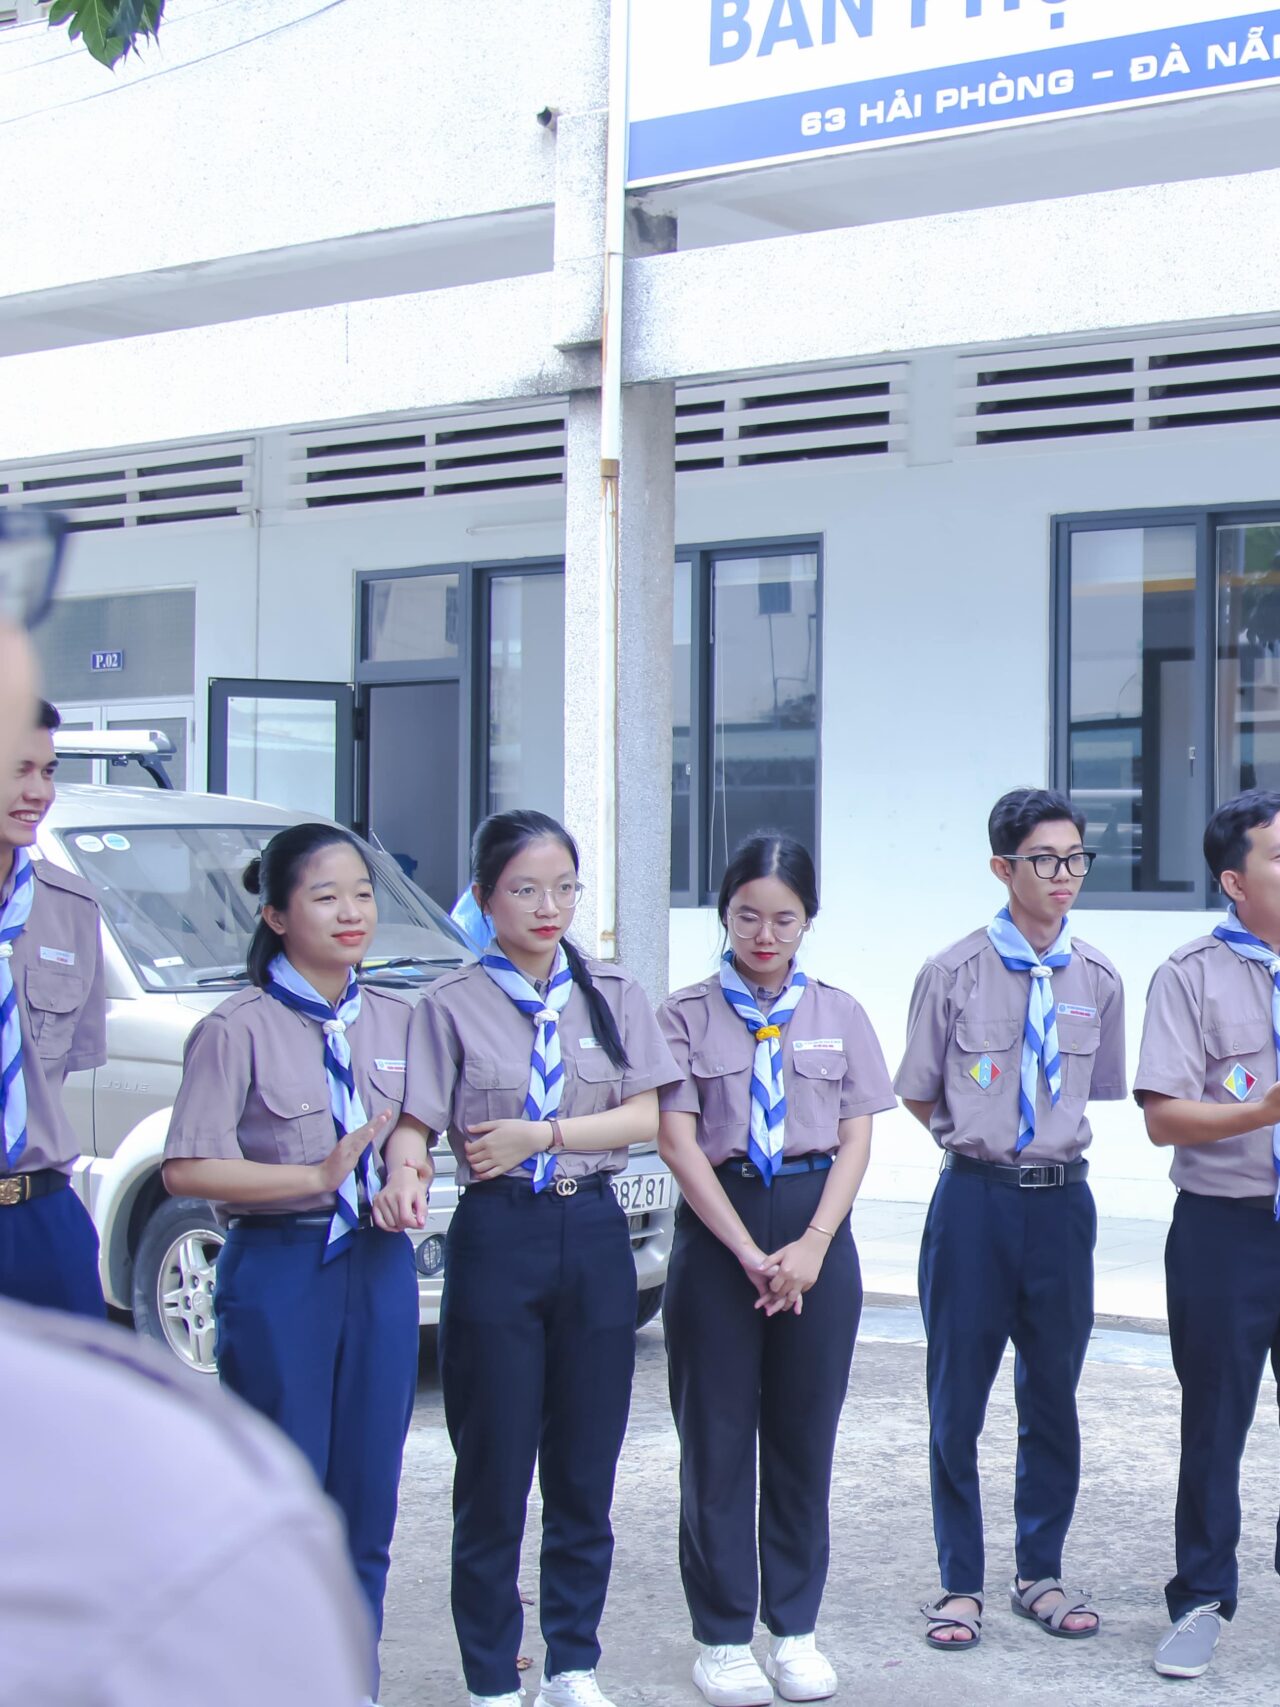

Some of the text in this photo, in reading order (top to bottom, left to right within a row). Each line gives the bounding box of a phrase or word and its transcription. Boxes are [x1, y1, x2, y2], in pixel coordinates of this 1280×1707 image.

[801, 107, 846, 136] 63
[859, 88, 922, 127] HẢI
[935, 69, 1075, 114] PHÒNG
[1129, 42, 1191, 83] ĐÀ
[95, 653, 119, 669] P.02
[101, 1080, 152, 1093] JOLIE
